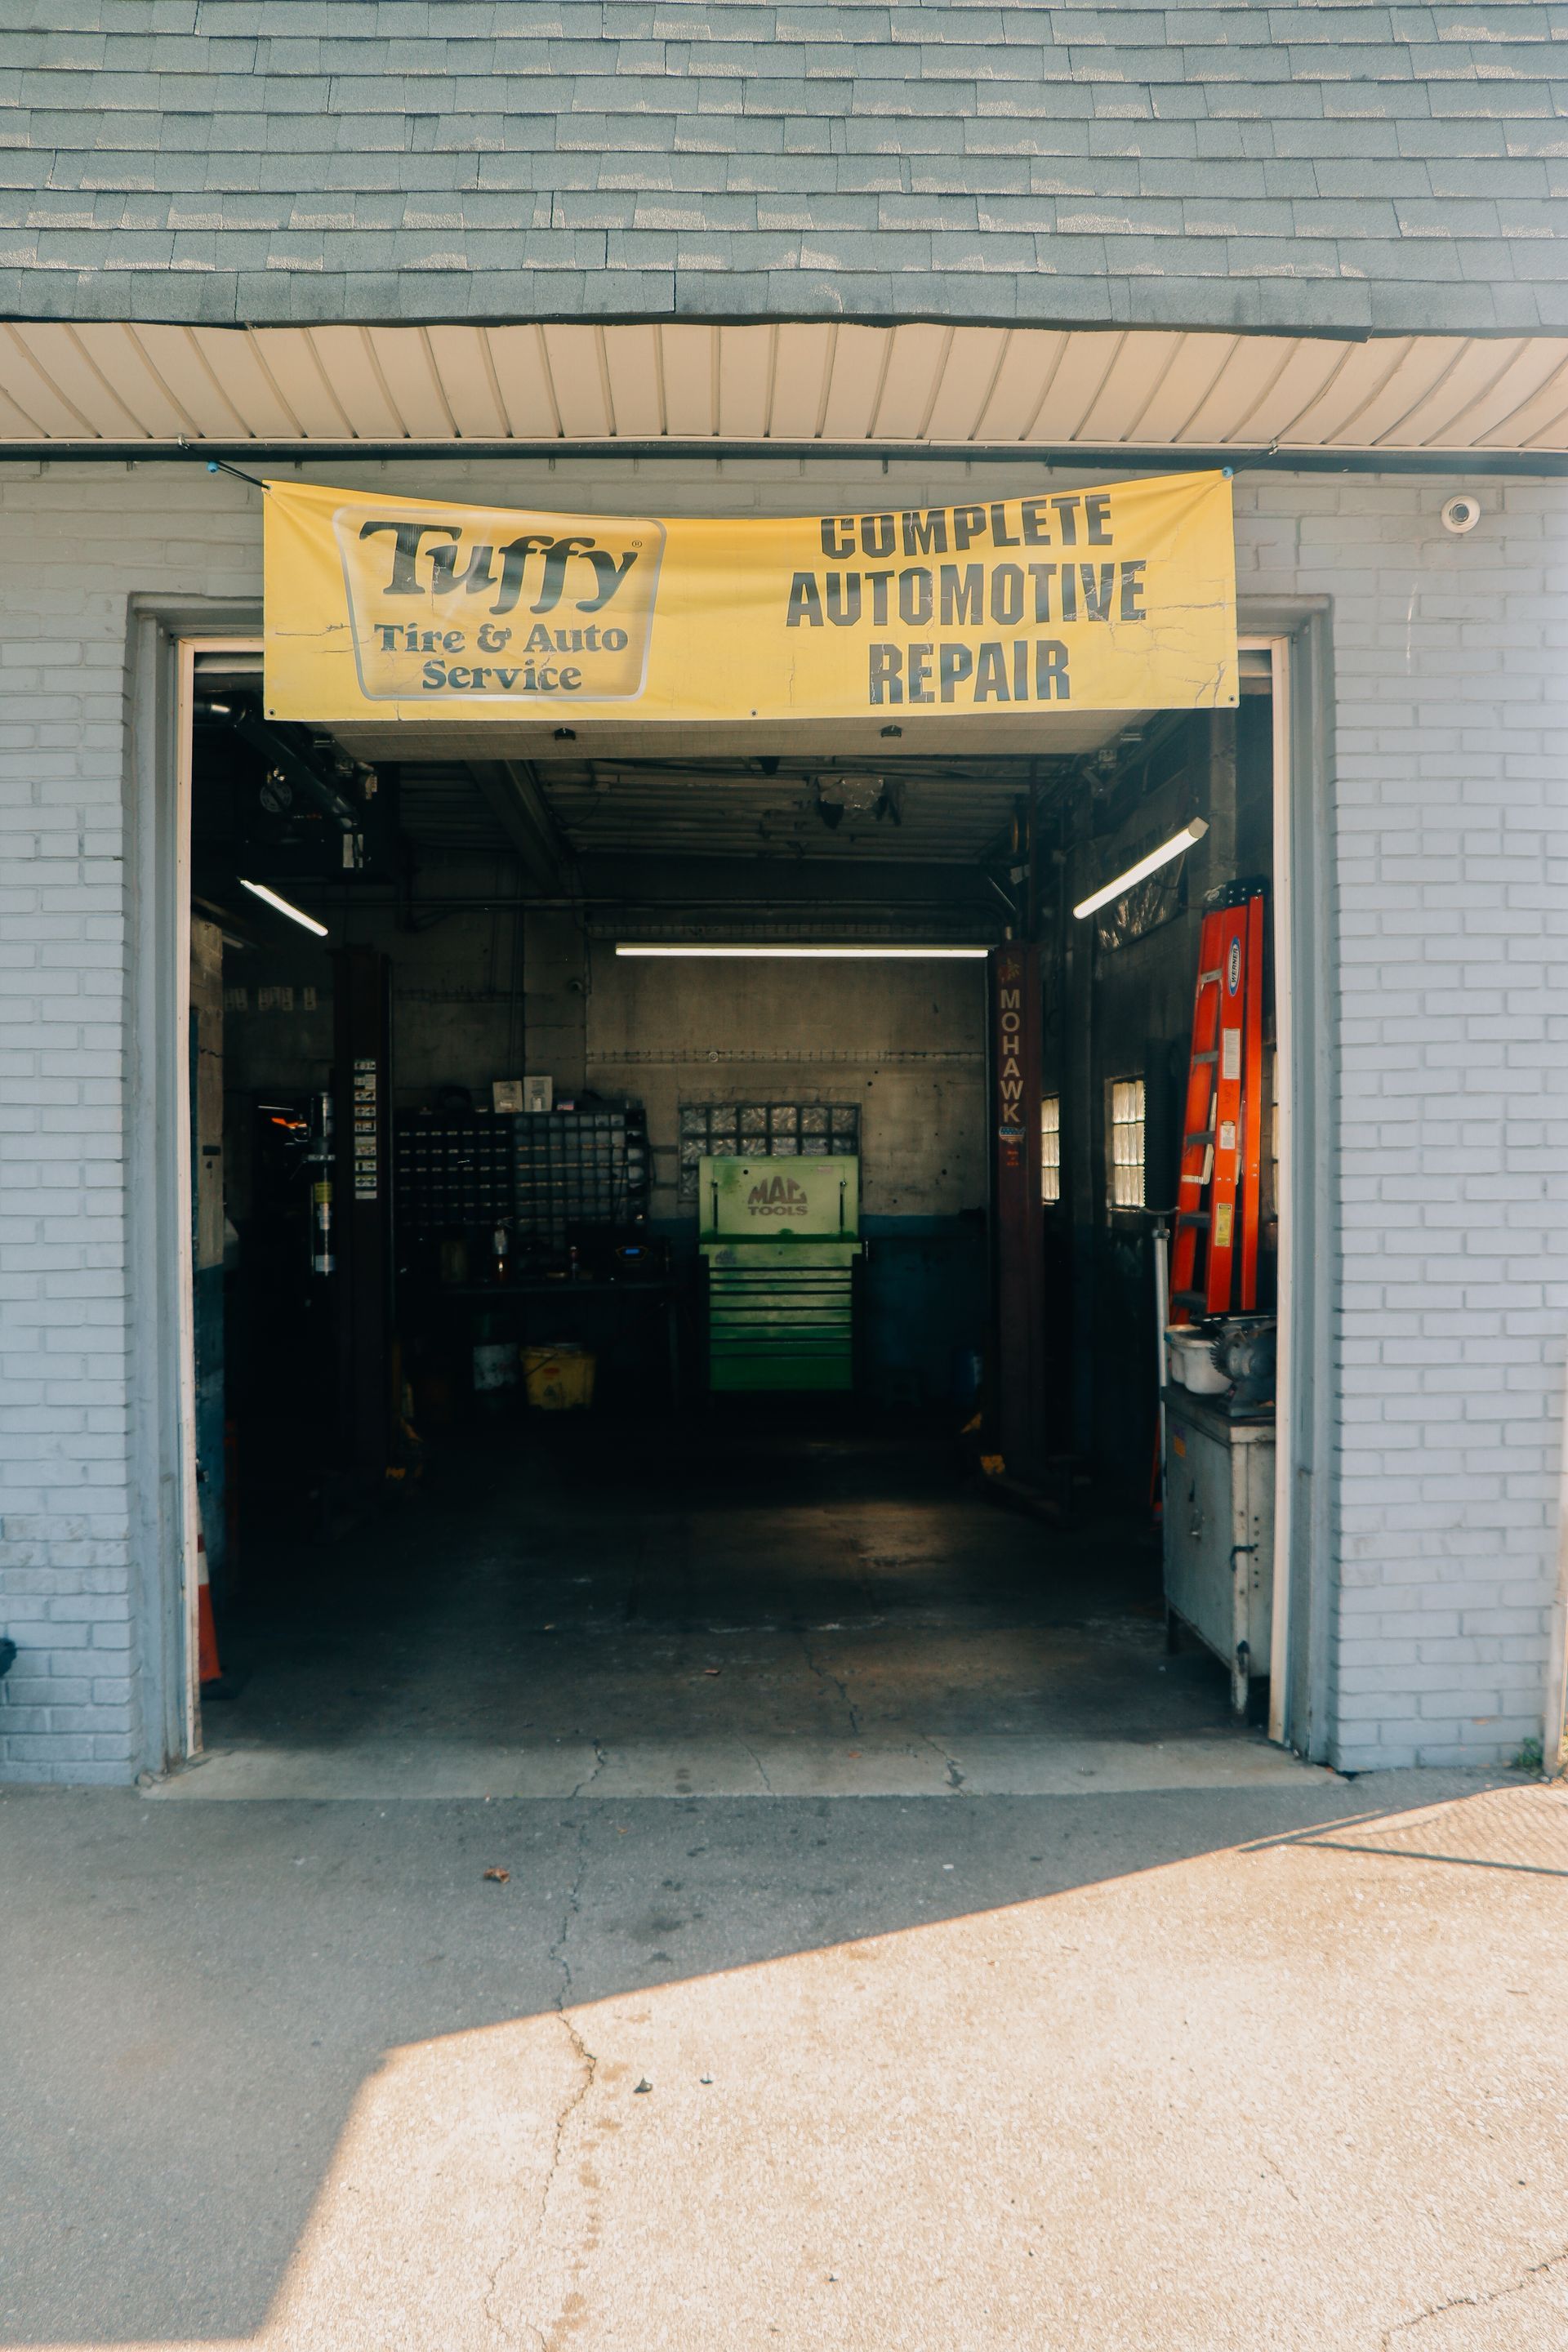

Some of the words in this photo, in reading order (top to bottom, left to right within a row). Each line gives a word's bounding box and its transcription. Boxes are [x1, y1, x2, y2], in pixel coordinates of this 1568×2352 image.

[821, 493, 1113, 559] COMPLETE
[359, 520, 638, 615] Tuffy
[786, 559, 1147, 626] AUTOMOTIVE
[374, 623, 466, 653] Tire
[477, 623, 511, 653] &
[523, 623, 628, 653] Auto
[421, 659, 581, 691] Service
[870, 639, 1070, 705] REPAIR
[1231, 947, 1239, 983] WERNER
[1000, 989, 1024, 1123] MOHAWK
[747, 1175, 808, 1205] MAC
[747, 1205, 808, 1216] TOOLS
